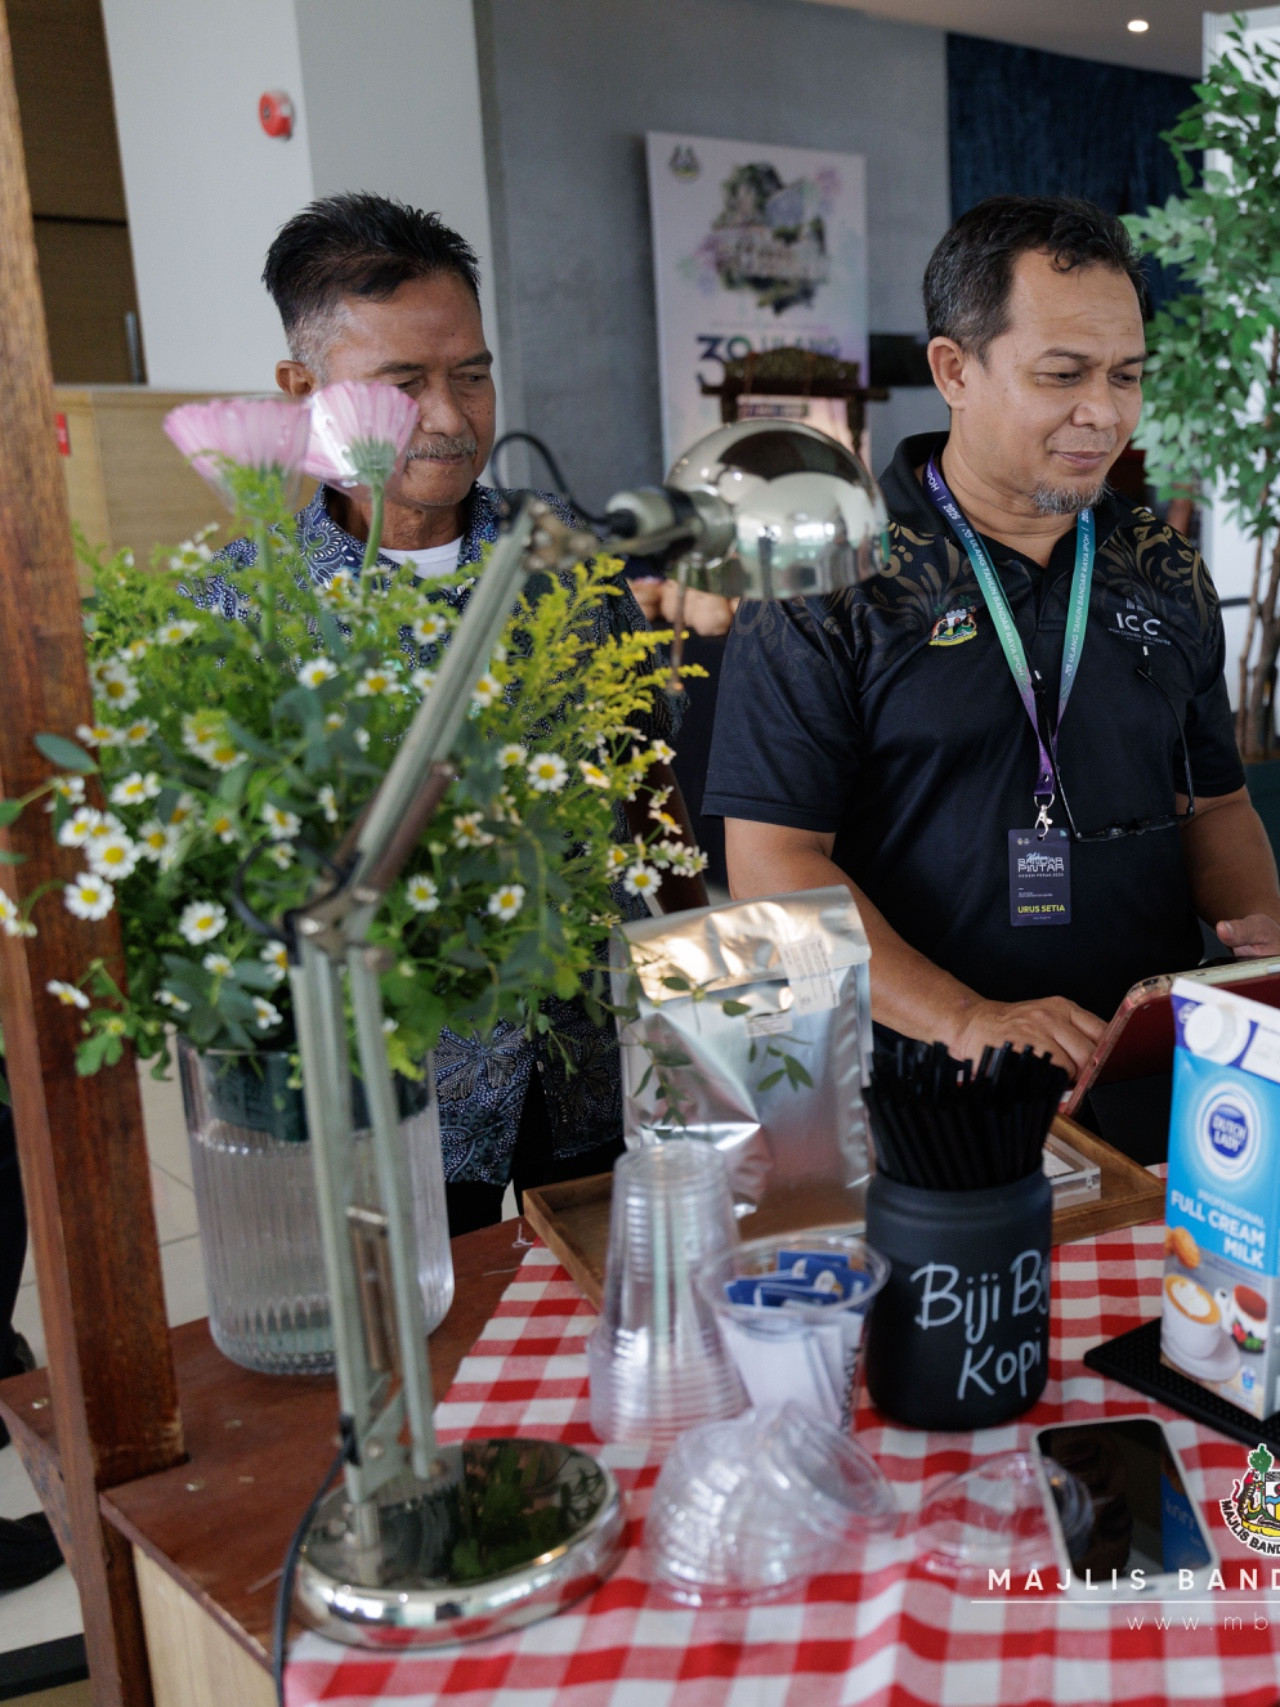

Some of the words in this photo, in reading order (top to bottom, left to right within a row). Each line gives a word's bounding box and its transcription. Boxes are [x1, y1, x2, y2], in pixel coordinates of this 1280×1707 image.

[1081, 553, 1090, 574] RAYA
[969, 540, 986, 566] ULANG
[983, 567, 999, 595] TAHUN
[993, 595, 1011, 631] BANDAR
[1004, 631, 1018, 655] RAYA
[1076, 573, 1089, 609] BANDAR
[1072, 610, 1084, 633] TAHUN
[1116, 612, 1161, 636] ICC
[1068, 634, 1080, 663] ULANG
[1017, 864, 1065, 872] PINTAR
[1017, 905, 1040, 913] URUS
[1041, 904, 1066, 912] SETIA
[1212, 1113, 1246, 1140] DUTCH
[1213, 1131, 1241, 1152] LADY
[1170, 1189, 1206, 1222] FULL
[1207, 1208, 1266, 1249] CREAM
[1223, 1236, 1265, 1269] MILK
[910, 1261, 1000, 1345] Biji
[957, 1325, 1042, 1400] Kopi
